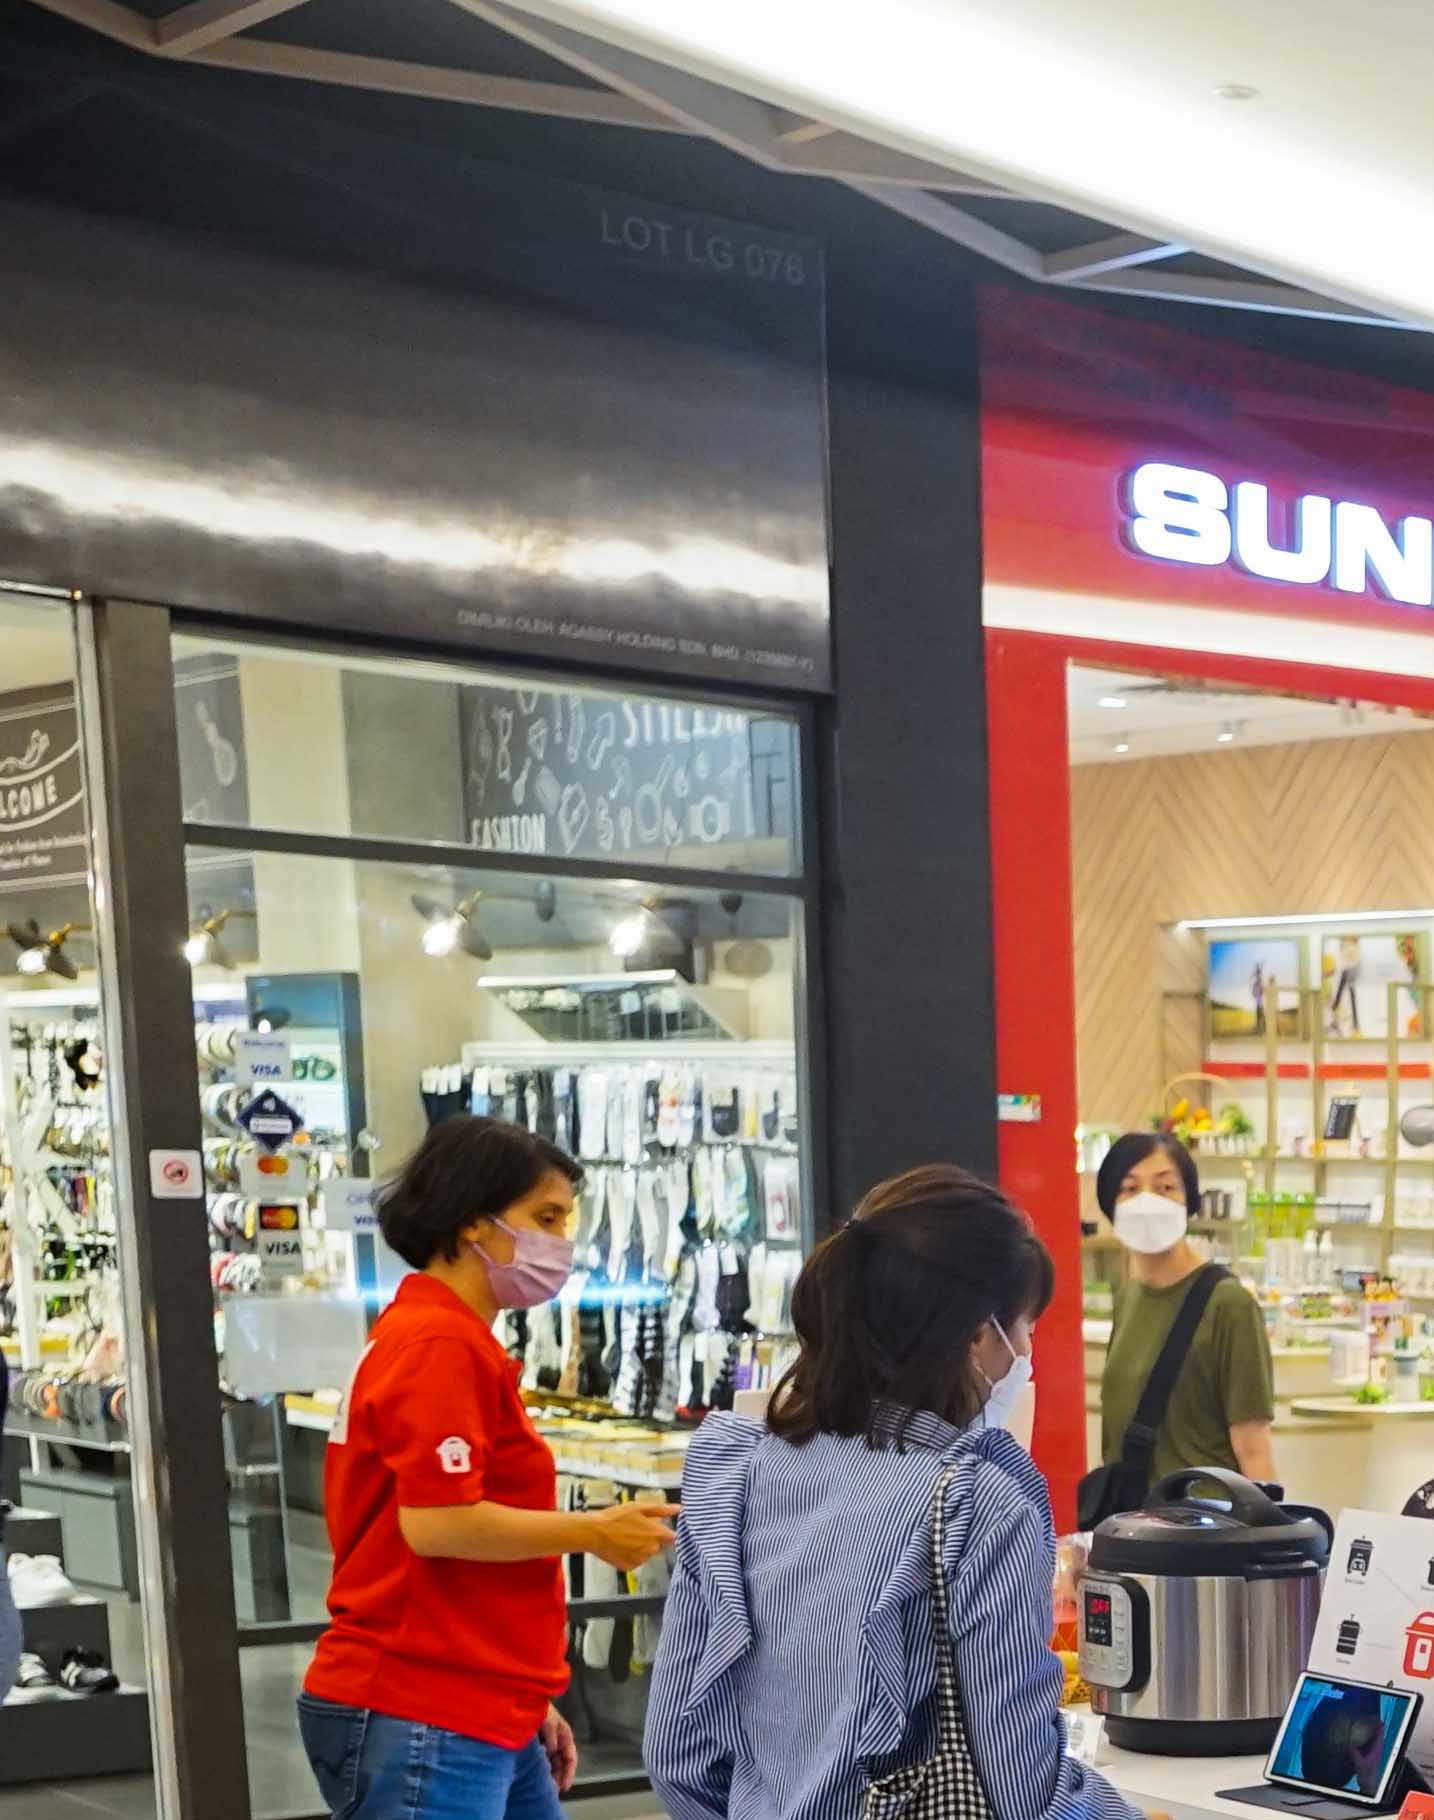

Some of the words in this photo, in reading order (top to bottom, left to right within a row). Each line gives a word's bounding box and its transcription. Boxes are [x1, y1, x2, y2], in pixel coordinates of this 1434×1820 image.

[600, 207, 672, 256] LOT
[685, 228, 735, 272] LG
[250, 1063, 281, 1077] VISA
[265, 1240, 300, 1256] VISA
